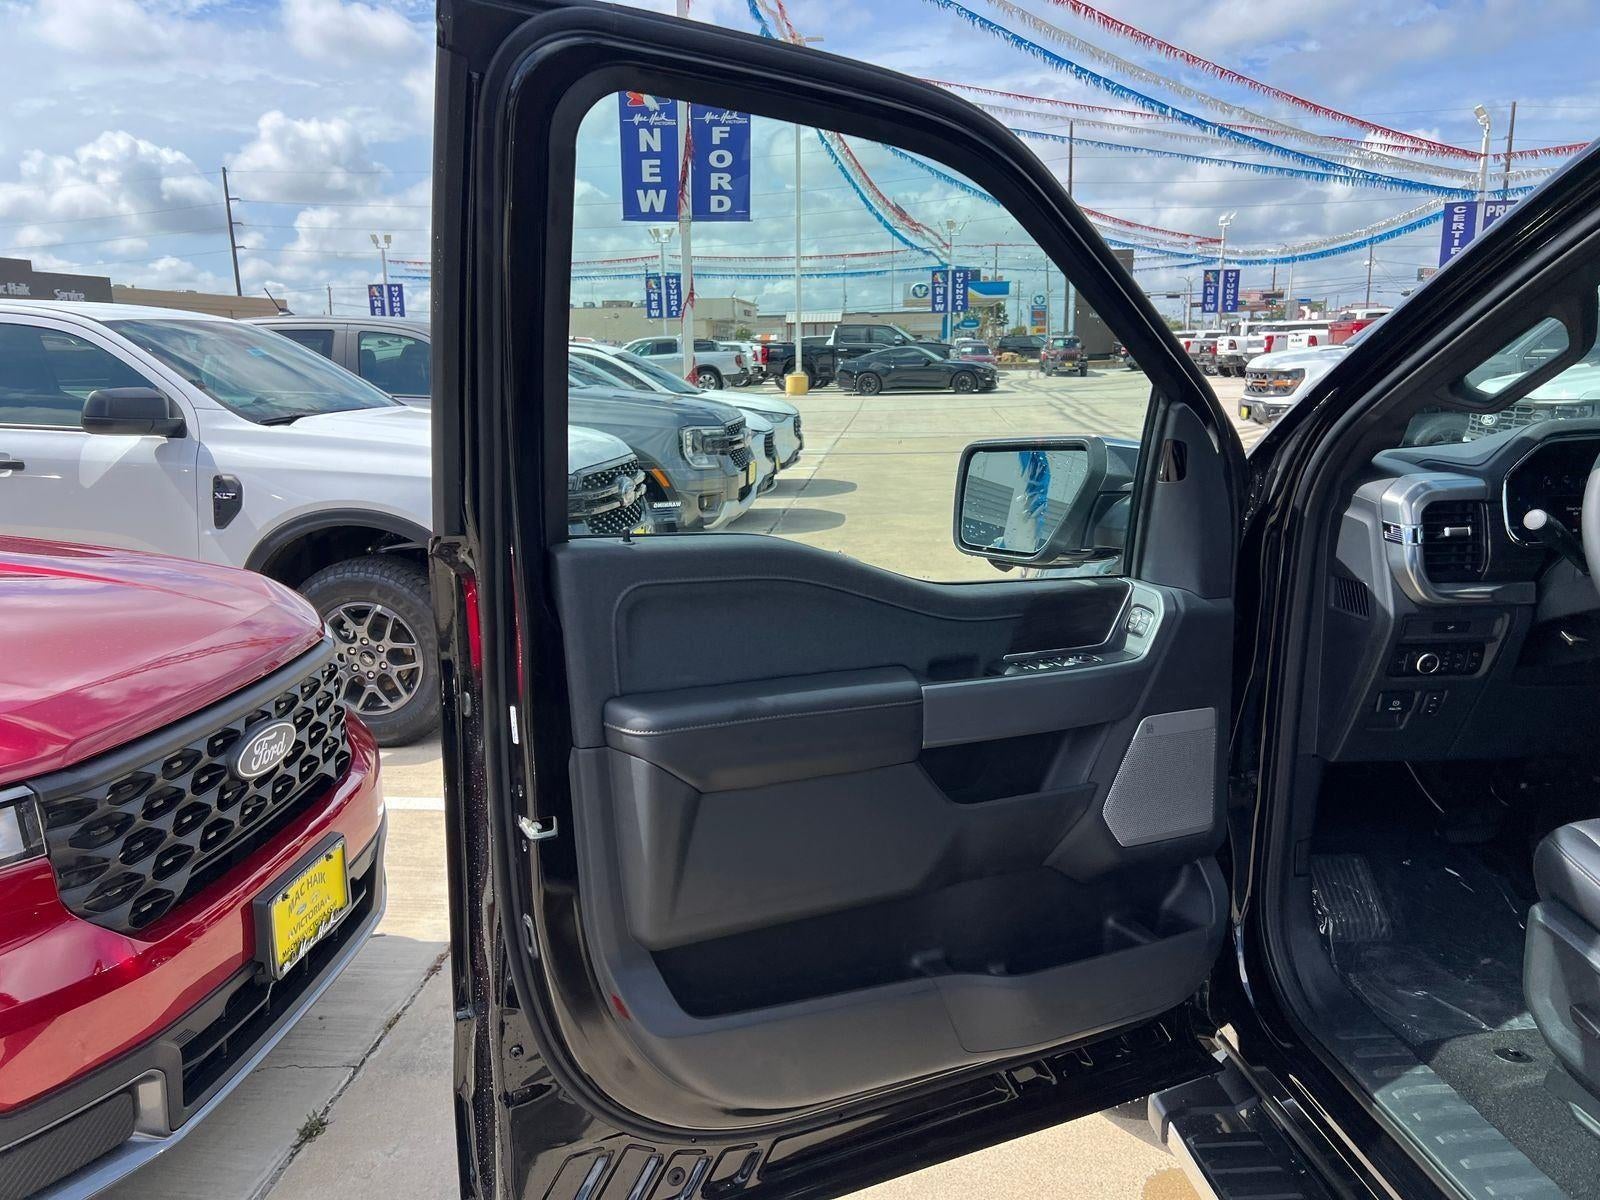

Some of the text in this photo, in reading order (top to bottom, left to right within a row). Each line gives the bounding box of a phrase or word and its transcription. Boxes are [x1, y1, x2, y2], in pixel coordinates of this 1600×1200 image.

[636, 127, 667, 213] NEW
[708, 126, 733, 213] FORD
[54, 288, 85, 302] Service
[650, 293, 660, 317] NEW
[668, 278, 678, 316] HYUNDAI
[934, 287, 945, 311] NEW
[955, 272, 964, 311] HYUNDAI
[1205, 287, 1215, 311] NEW
[1226, 271, 1236, 311] HYUNDAI
[214, 492, 236, 500] XLT
[251, 731, 286, 771] Ford
[288, 882, 306, 918] MAC
[306, 871, 326, 890] HAIK
[292, 901, 327, 935] VICTORIA
